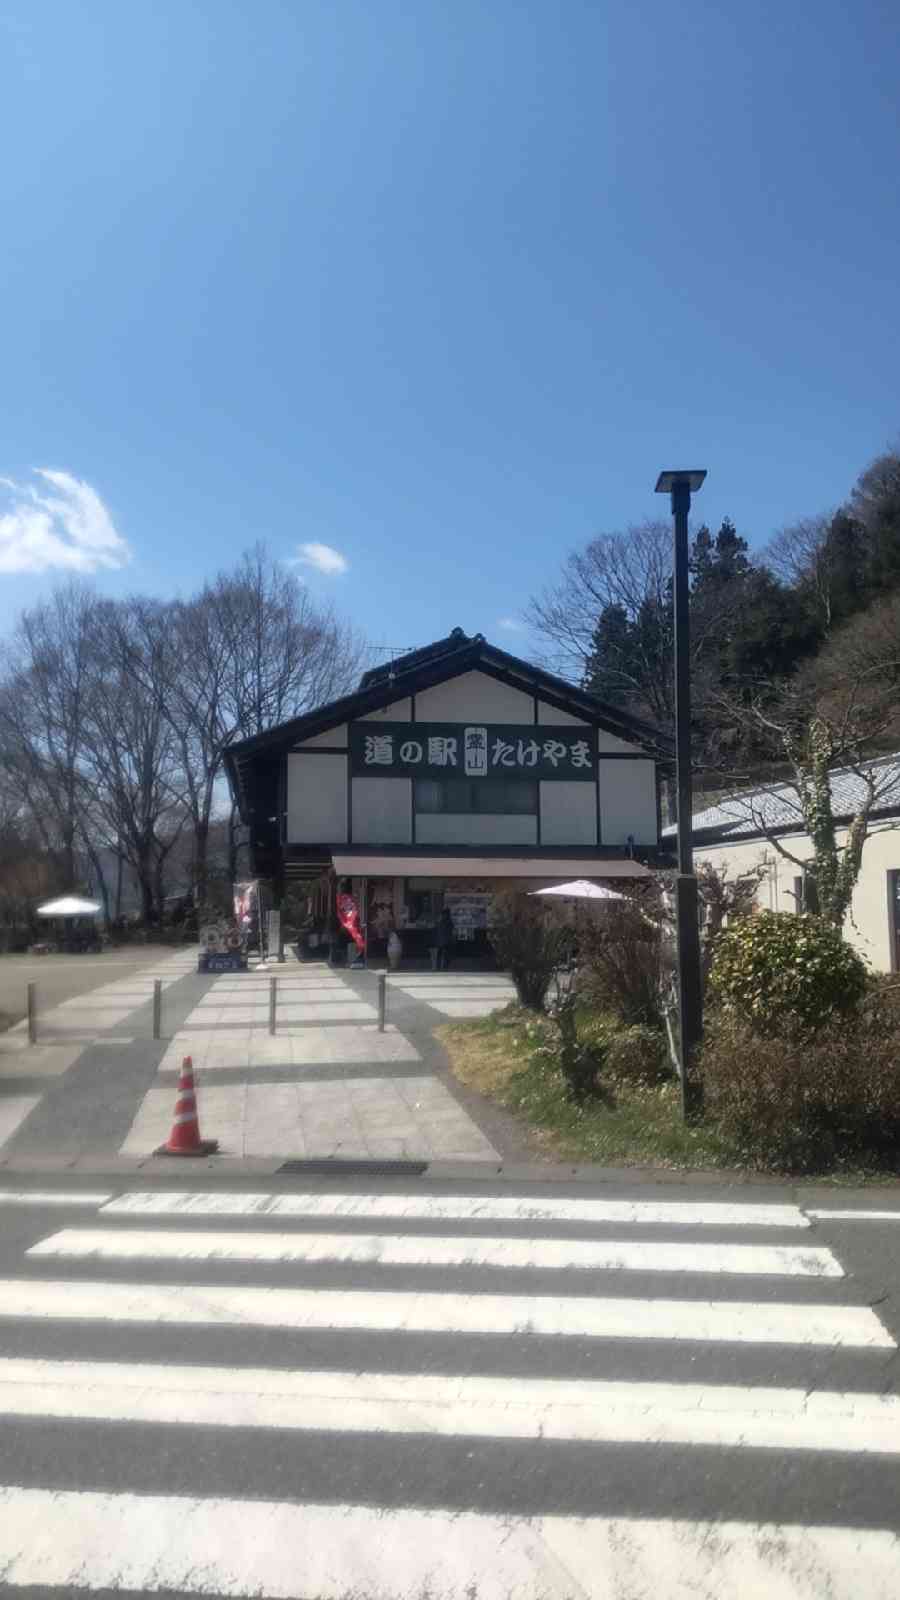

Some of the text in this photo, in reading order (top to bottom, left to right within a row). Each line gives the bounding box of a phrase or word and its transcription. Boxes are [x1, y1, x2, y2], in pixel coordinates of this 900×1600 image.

[364, 735, 457, 767] 道の駅
[491, 738, 593, 768] たけやま
